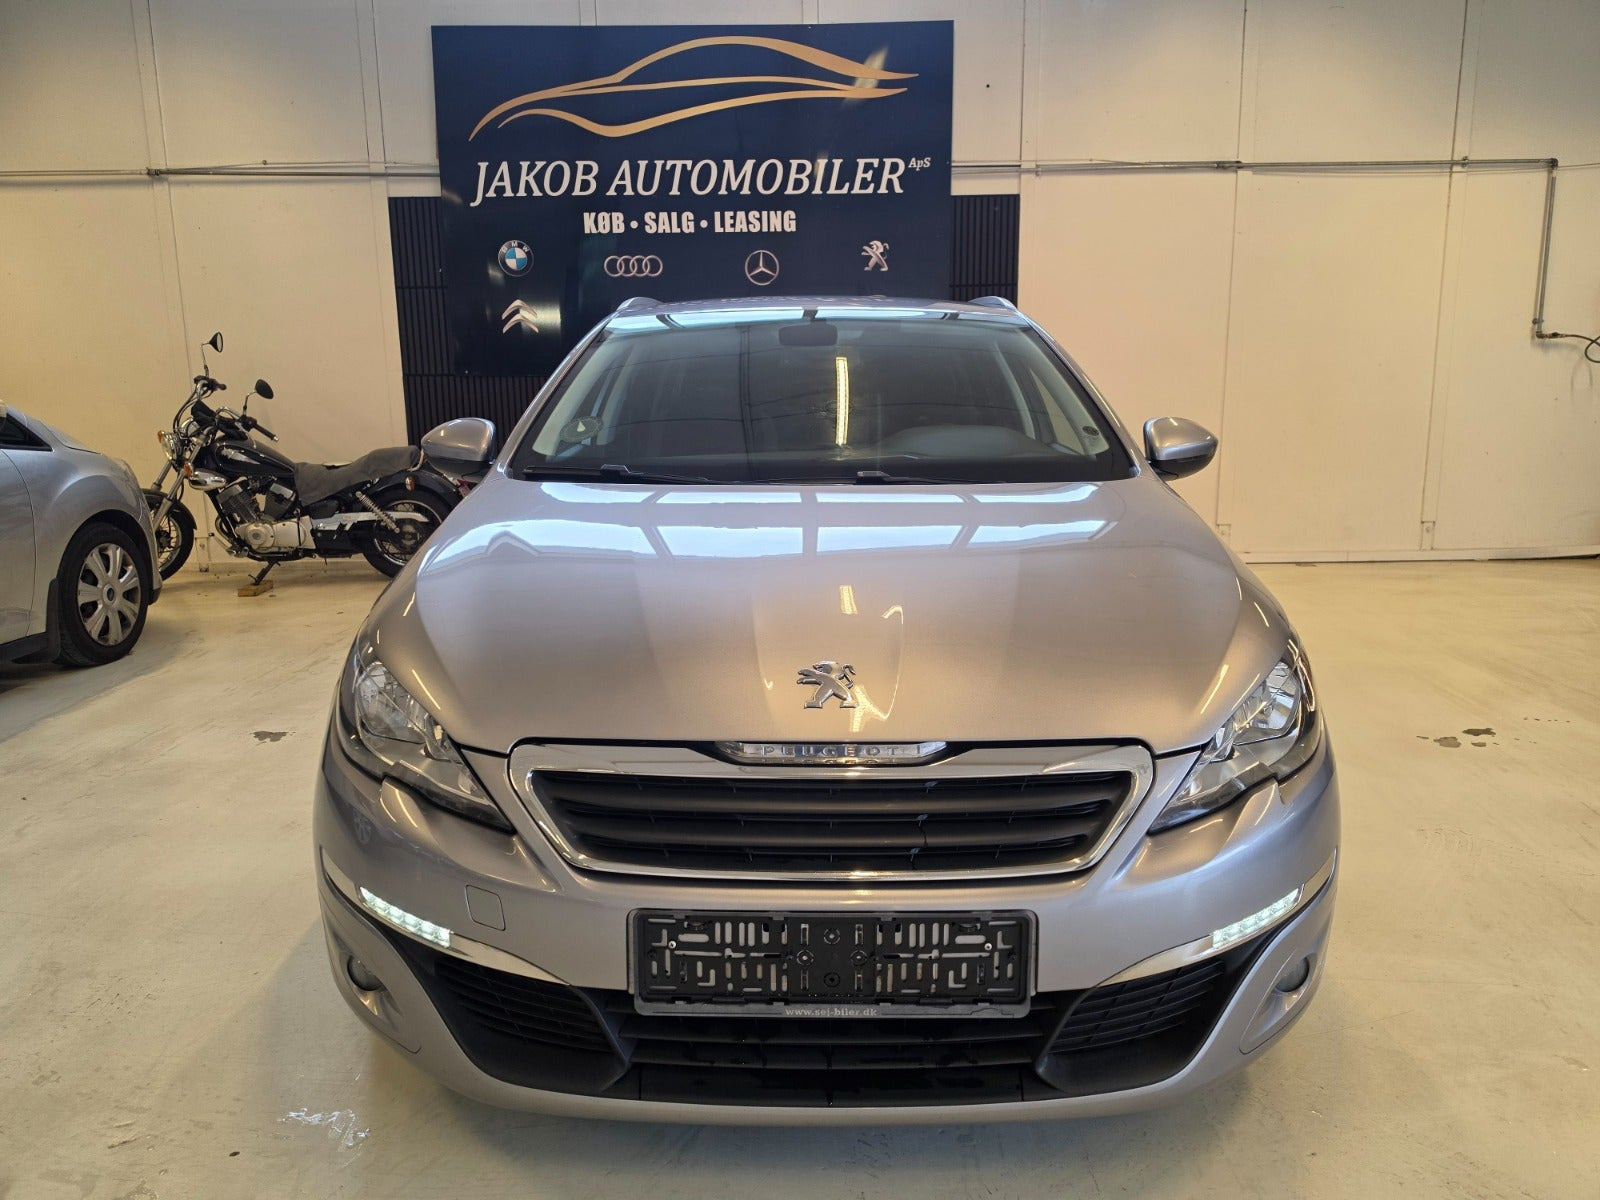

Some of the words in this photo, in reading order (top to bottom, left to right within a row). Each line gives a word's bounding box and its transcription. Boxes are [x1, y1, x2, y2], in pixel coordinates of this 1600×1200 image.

[469, 160, 599, 207] JAKOB
[605, 157, 906, 196] AUTOMOBILER
[908, 157, 931, 171] ApS
[583, 211, 625, 234] KØB
[644, 211, 695, 234] SALG
[714, 210, 797, 233] LEASING
[762, 745, 899, 757] PEUGEOT
